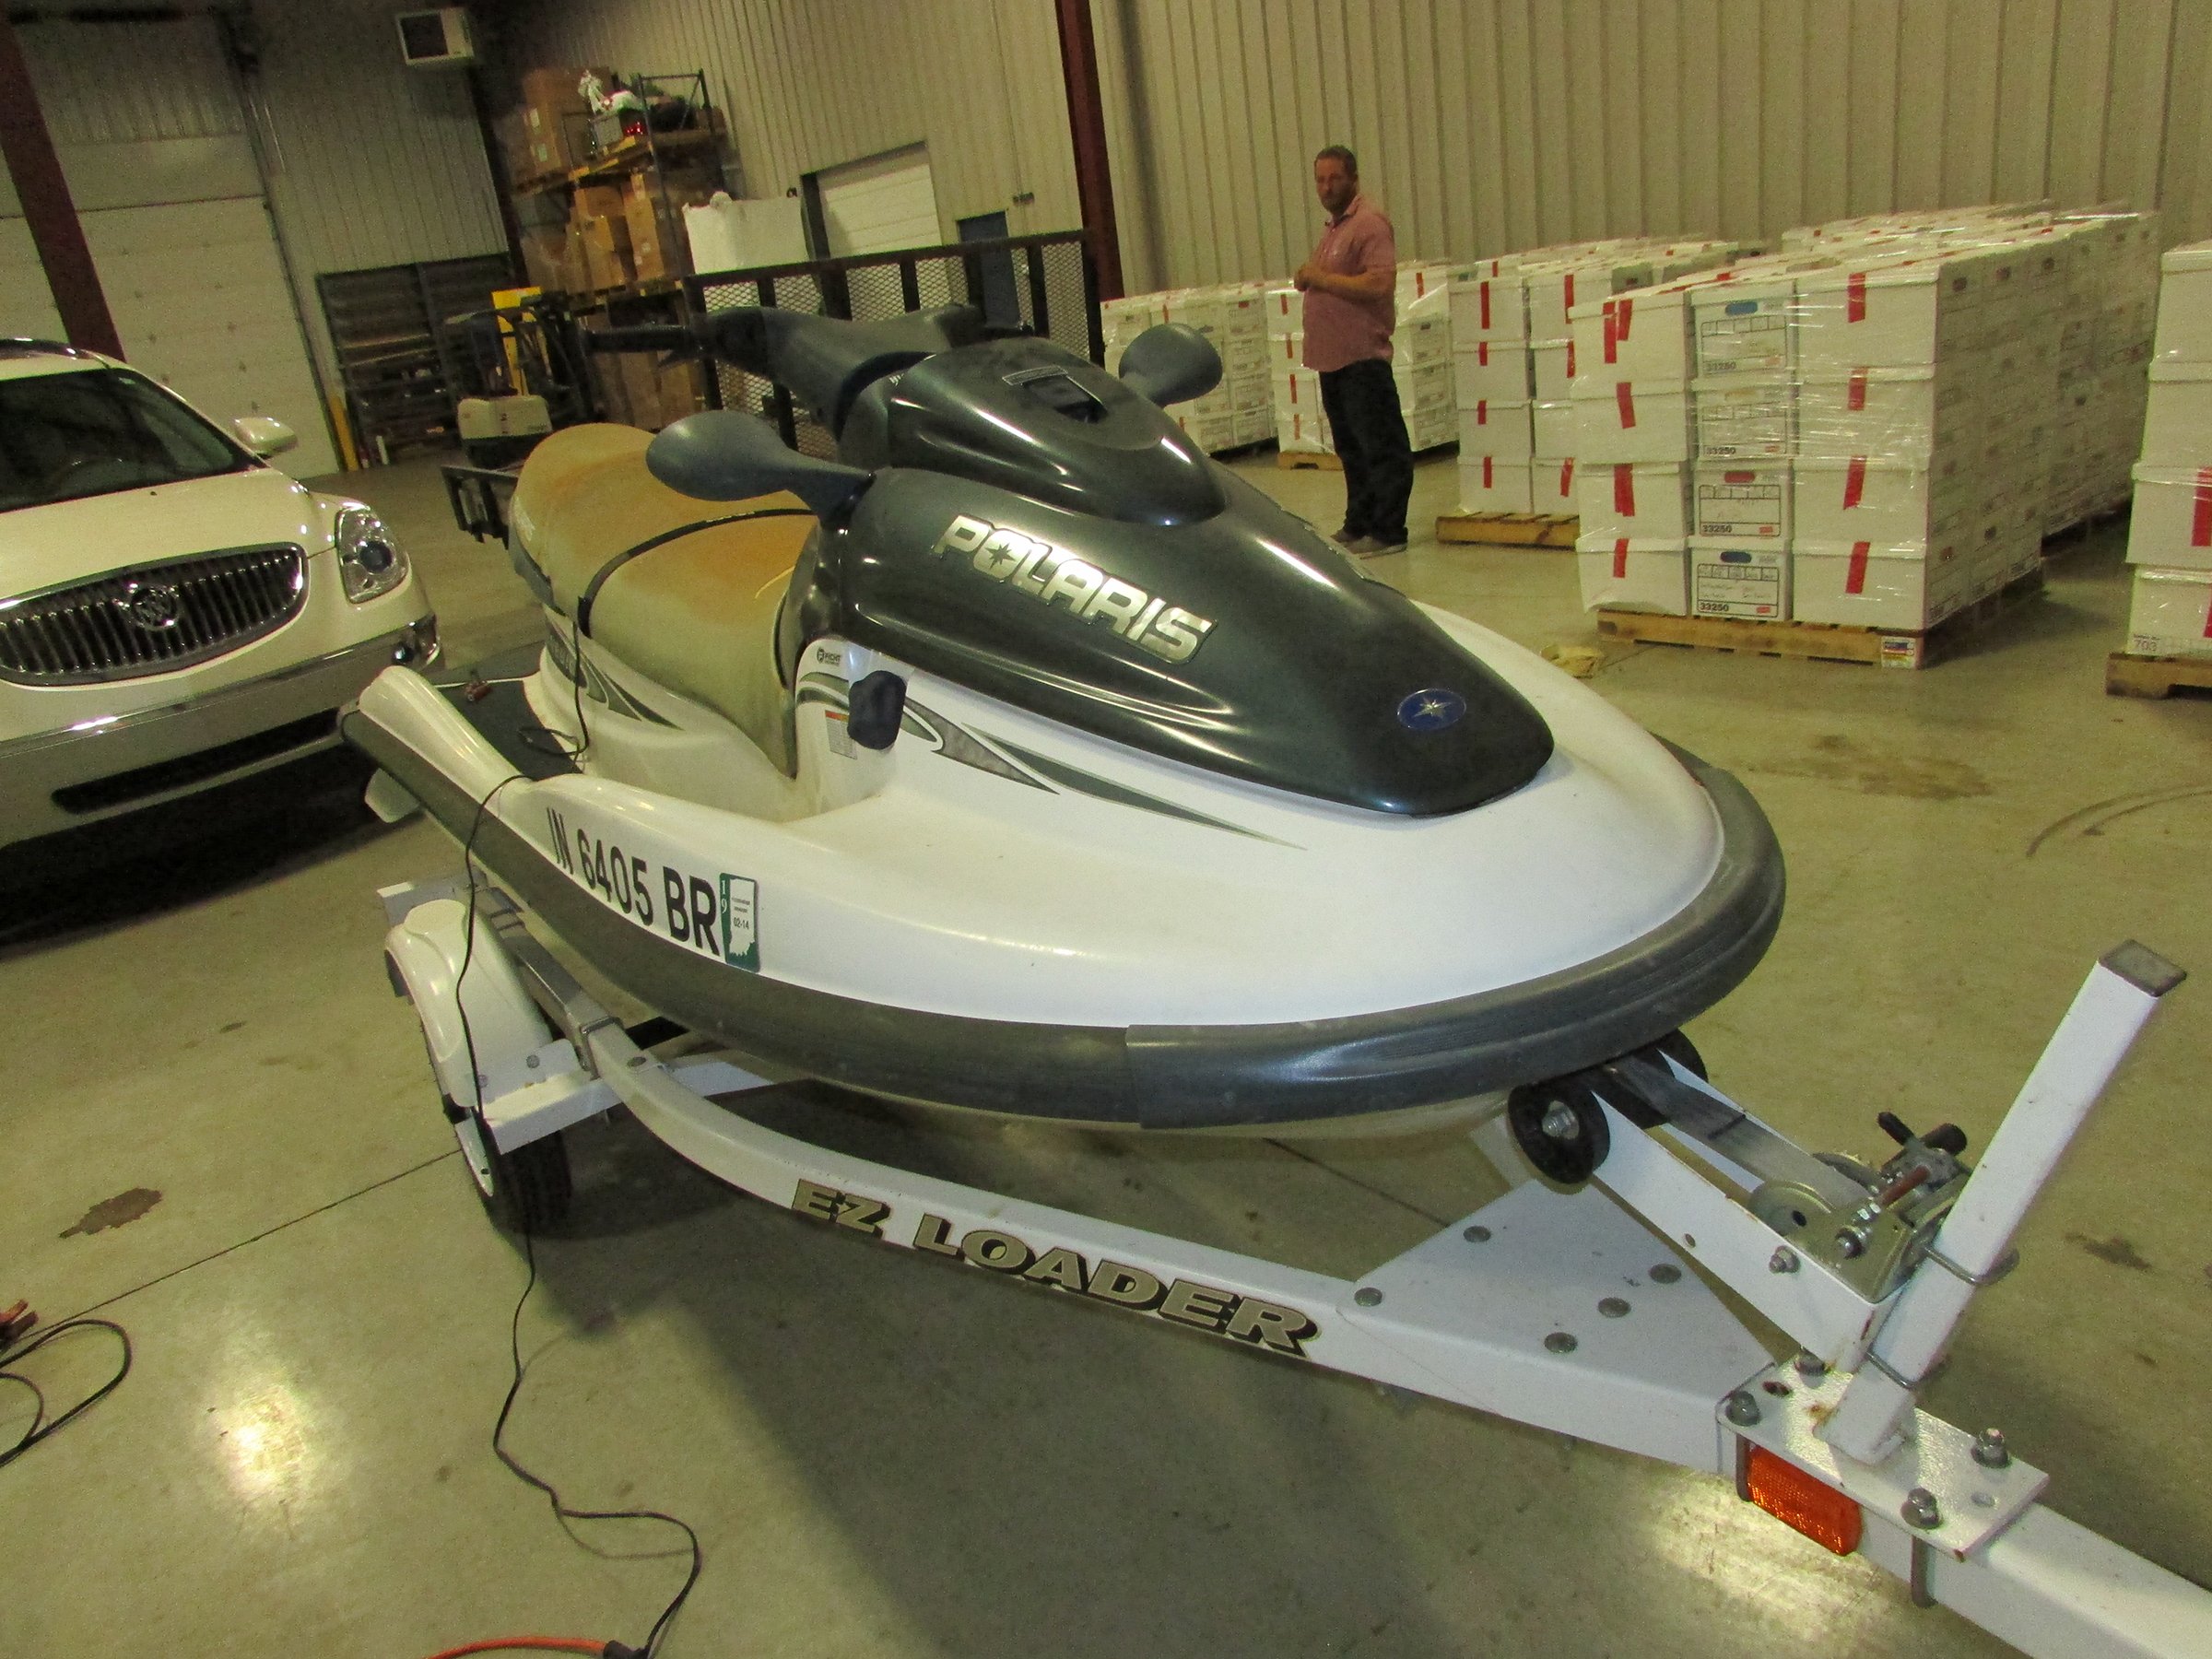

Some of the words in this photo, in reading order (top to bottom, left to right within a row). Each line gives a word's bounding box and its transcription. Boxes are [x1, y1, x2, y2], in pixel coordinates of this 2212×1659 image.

[930, 513, 1218, 665] POLARIS
[1702, 524, 1732, 533] 33250
[1700, 602, 1729, 612] 33250
[547, 807, 573, 875] IN
[578, 829, 653, 926] 6405
[663, 865, 720, 957] BR
[792, 1178, 891, 1239] EZ
[912, 1213, 1321, 1359] LOADER
